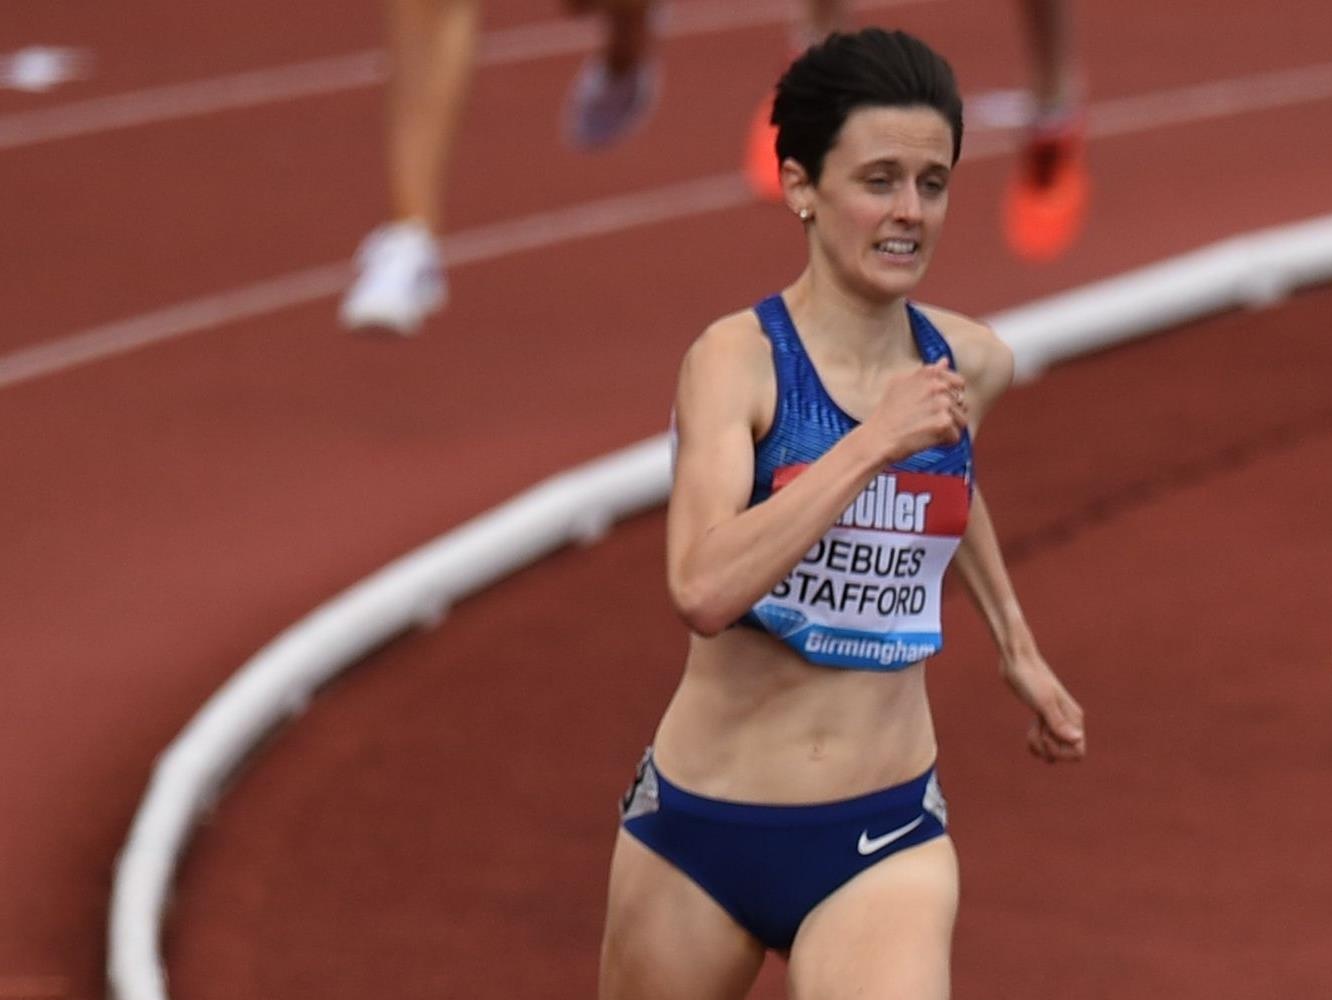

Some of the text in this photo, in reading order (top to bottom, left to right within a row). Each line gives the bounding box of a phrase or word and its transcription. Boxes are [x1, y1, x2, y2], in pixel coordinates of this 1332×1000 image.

[836, 474, 931, 533] üller
[802, 539, 926, 578] DEBUES
[771, 570, 927, 616] STAFFORD
[804, 631, 937, 665] Birmingham
